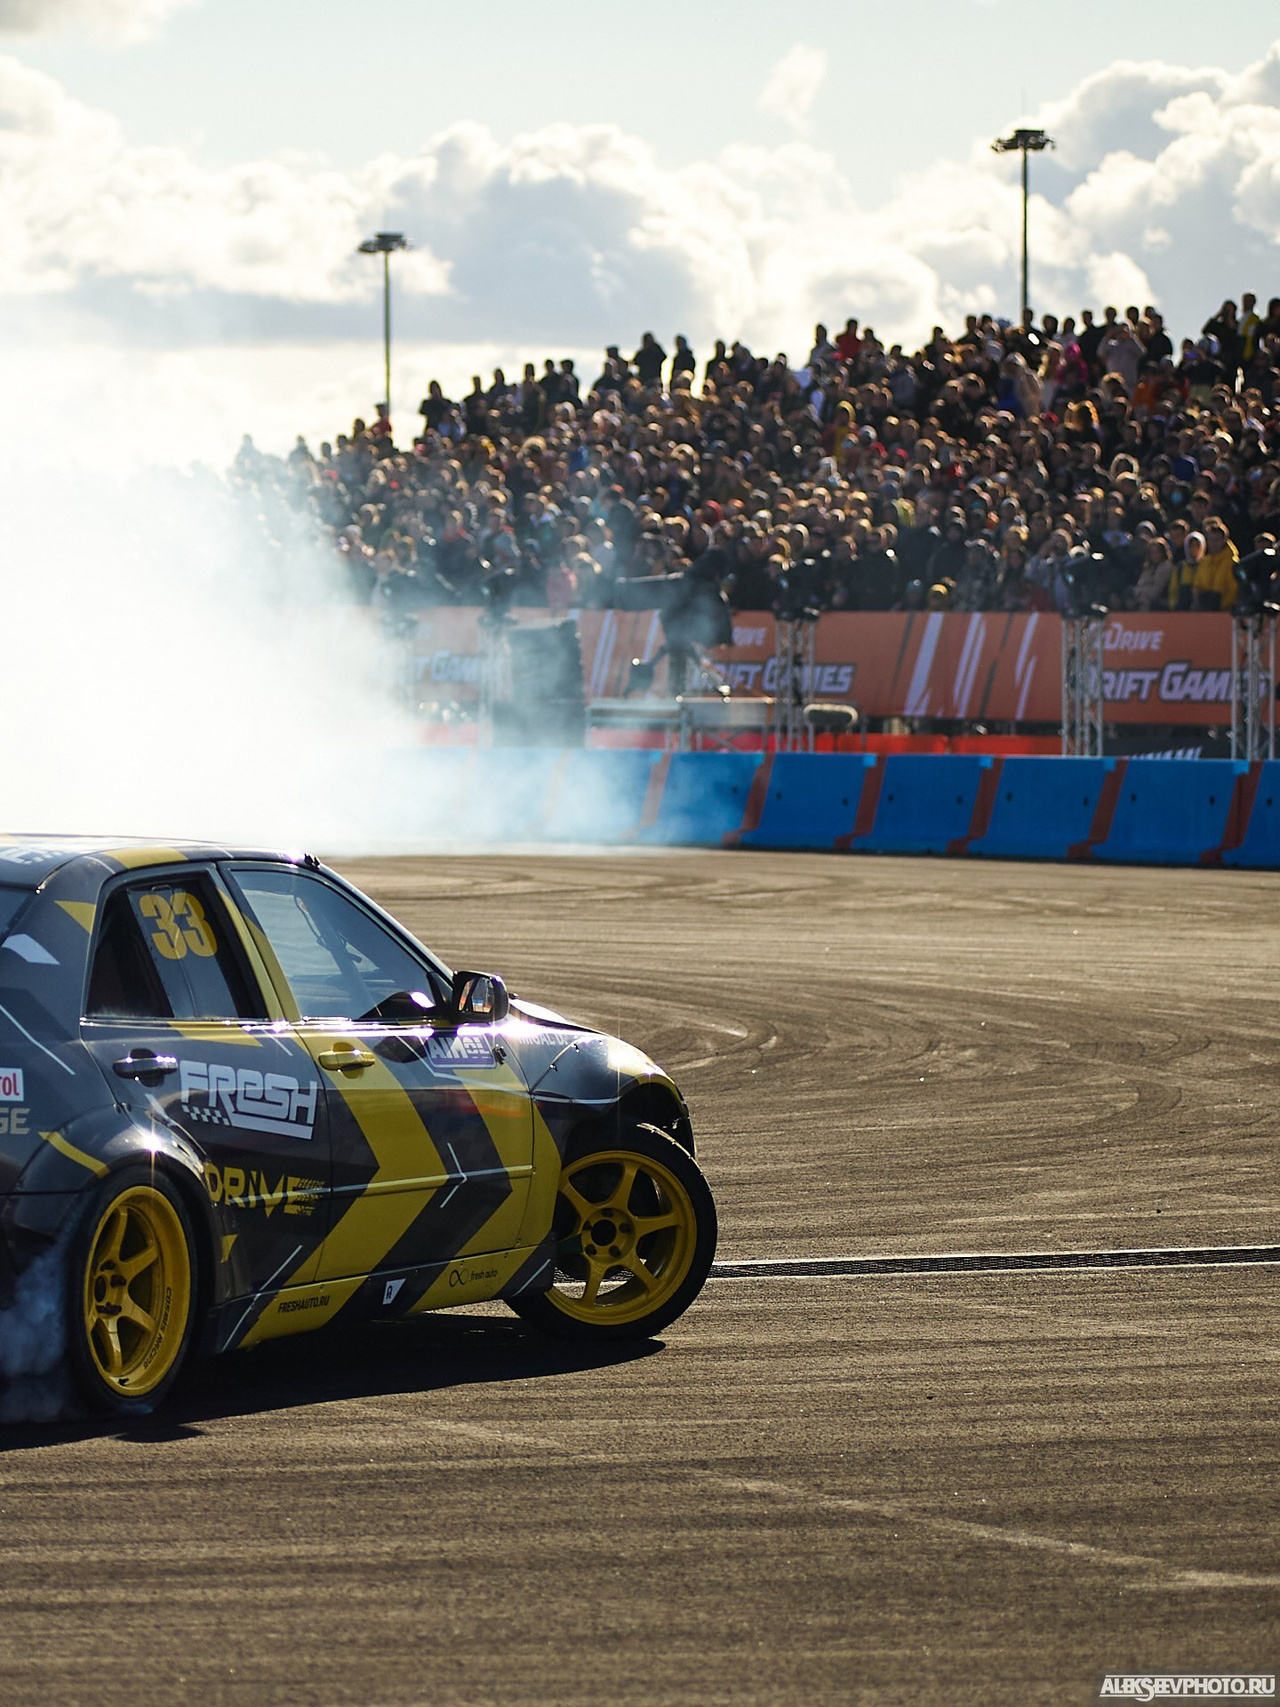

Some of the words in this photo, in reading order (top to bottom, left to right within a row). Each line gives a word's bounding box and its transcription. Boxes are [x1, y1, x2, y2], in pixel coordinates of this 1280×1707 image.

[139, 892, 218, 960] 33
[203, 1160, 322, 1218] DRIVE
[278, 1295, 330, 1313] FRESHAUTO.RU
